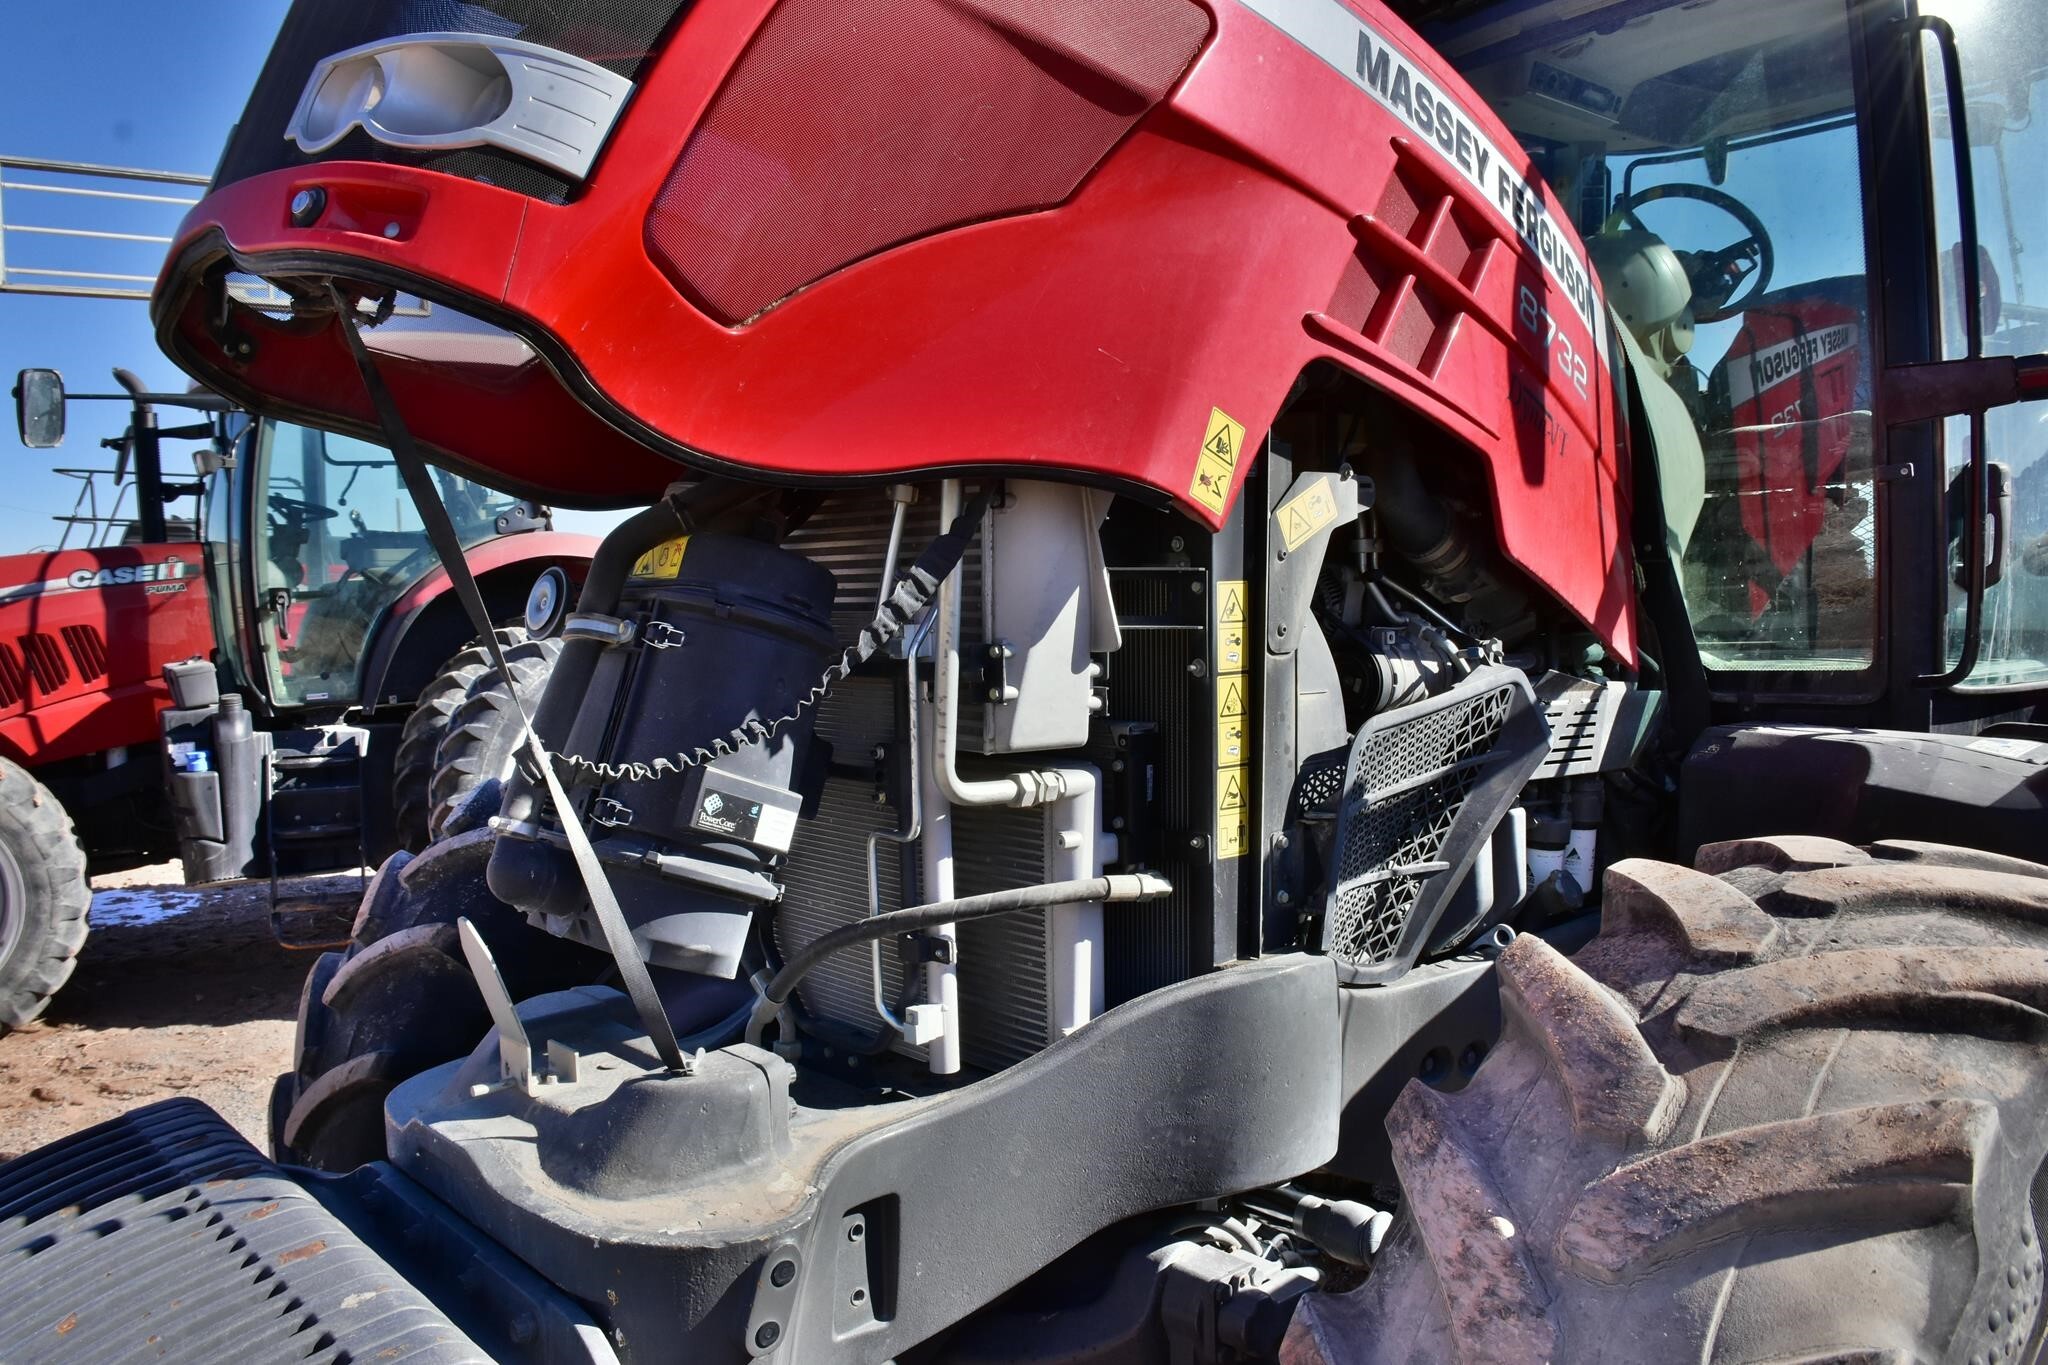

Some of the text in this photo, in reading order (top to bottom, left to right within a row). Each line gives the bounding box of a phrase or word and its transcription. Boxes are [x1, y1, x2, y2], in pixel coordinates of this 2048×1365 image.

[1355, 29, 1596, 324] MASSEY FERGUSON
[1519, 284, 1588, 401] 8732
[68, 565, 155, 589] CASE
[145, 583, 187, 595] PUMA
[699, 811, 737, 830] PowerCore
